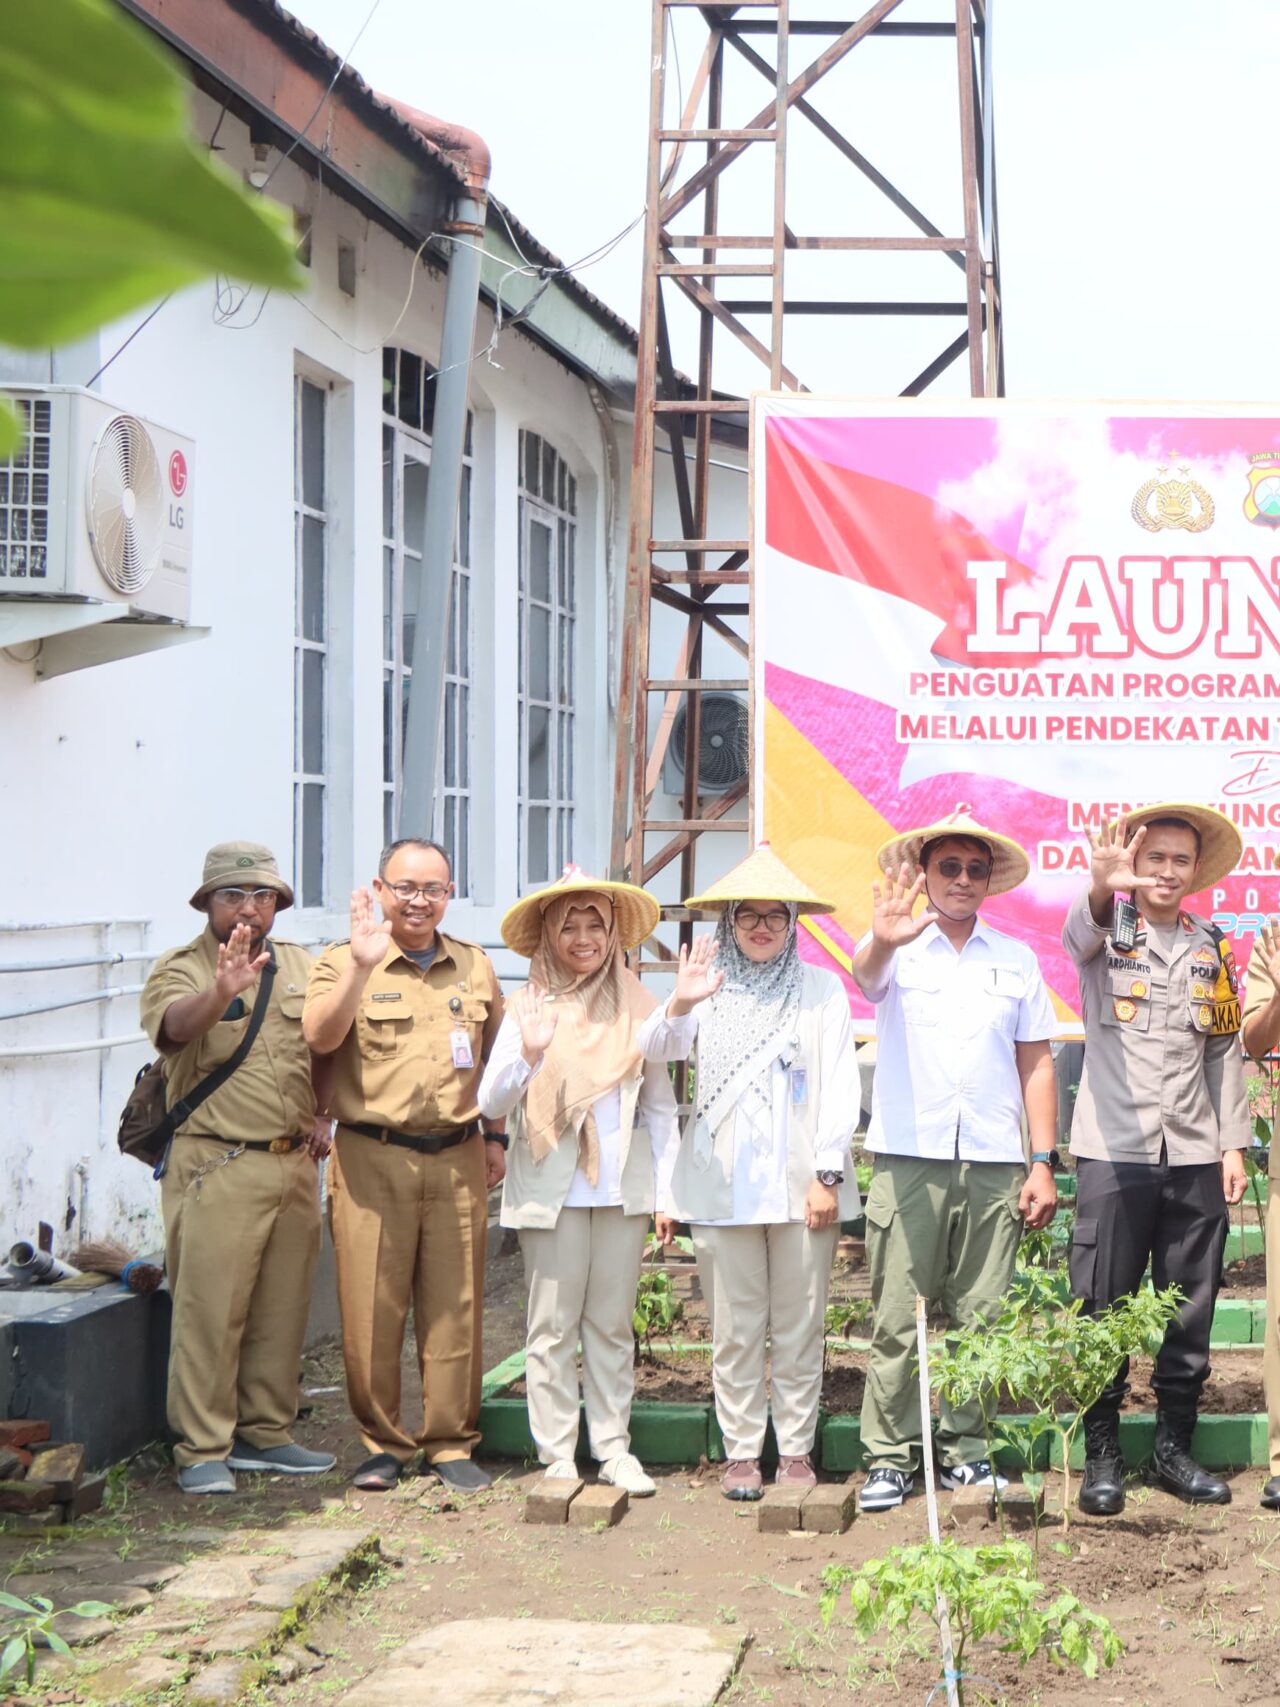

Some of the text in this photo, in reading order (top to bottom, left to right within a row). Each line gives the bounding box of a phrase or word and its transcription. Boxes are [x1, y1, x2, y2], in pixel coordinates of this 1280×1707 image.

[1252, 453, 1271, 462] JAWA
[168, 503, 185, 530] LG
[909, 672, 1115, 698] PENGUATAN
[899, 715, 1037, 740] MELALUI
[1045, 716, 1269, 741] PENDEKATAN
[1107, 956, 1152, 974] ARDHIANTO
[1190, 965, 1220, 979] POL
